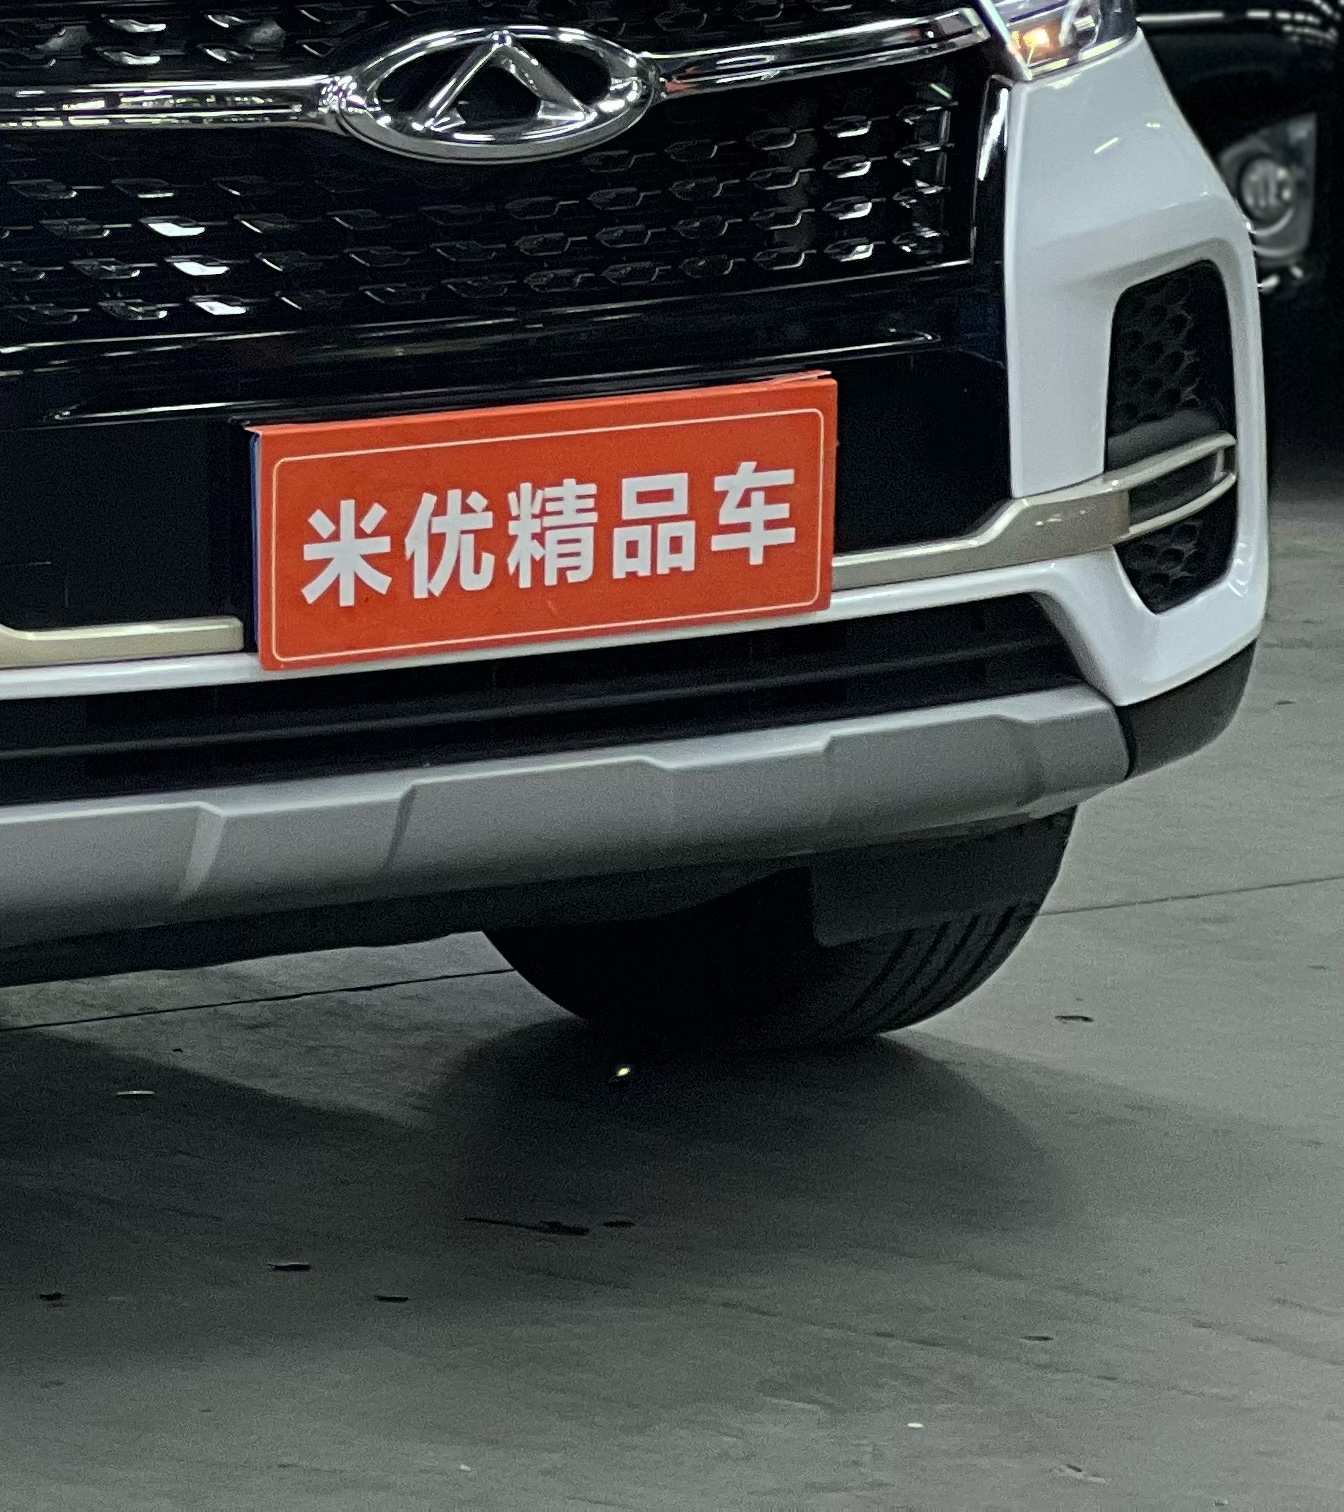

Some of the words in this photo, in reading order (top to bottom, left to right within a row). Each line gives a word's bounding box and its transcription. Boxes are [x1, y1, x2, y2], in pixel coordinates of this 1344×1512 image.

[301, 460, 797, 607] 米优精品车
